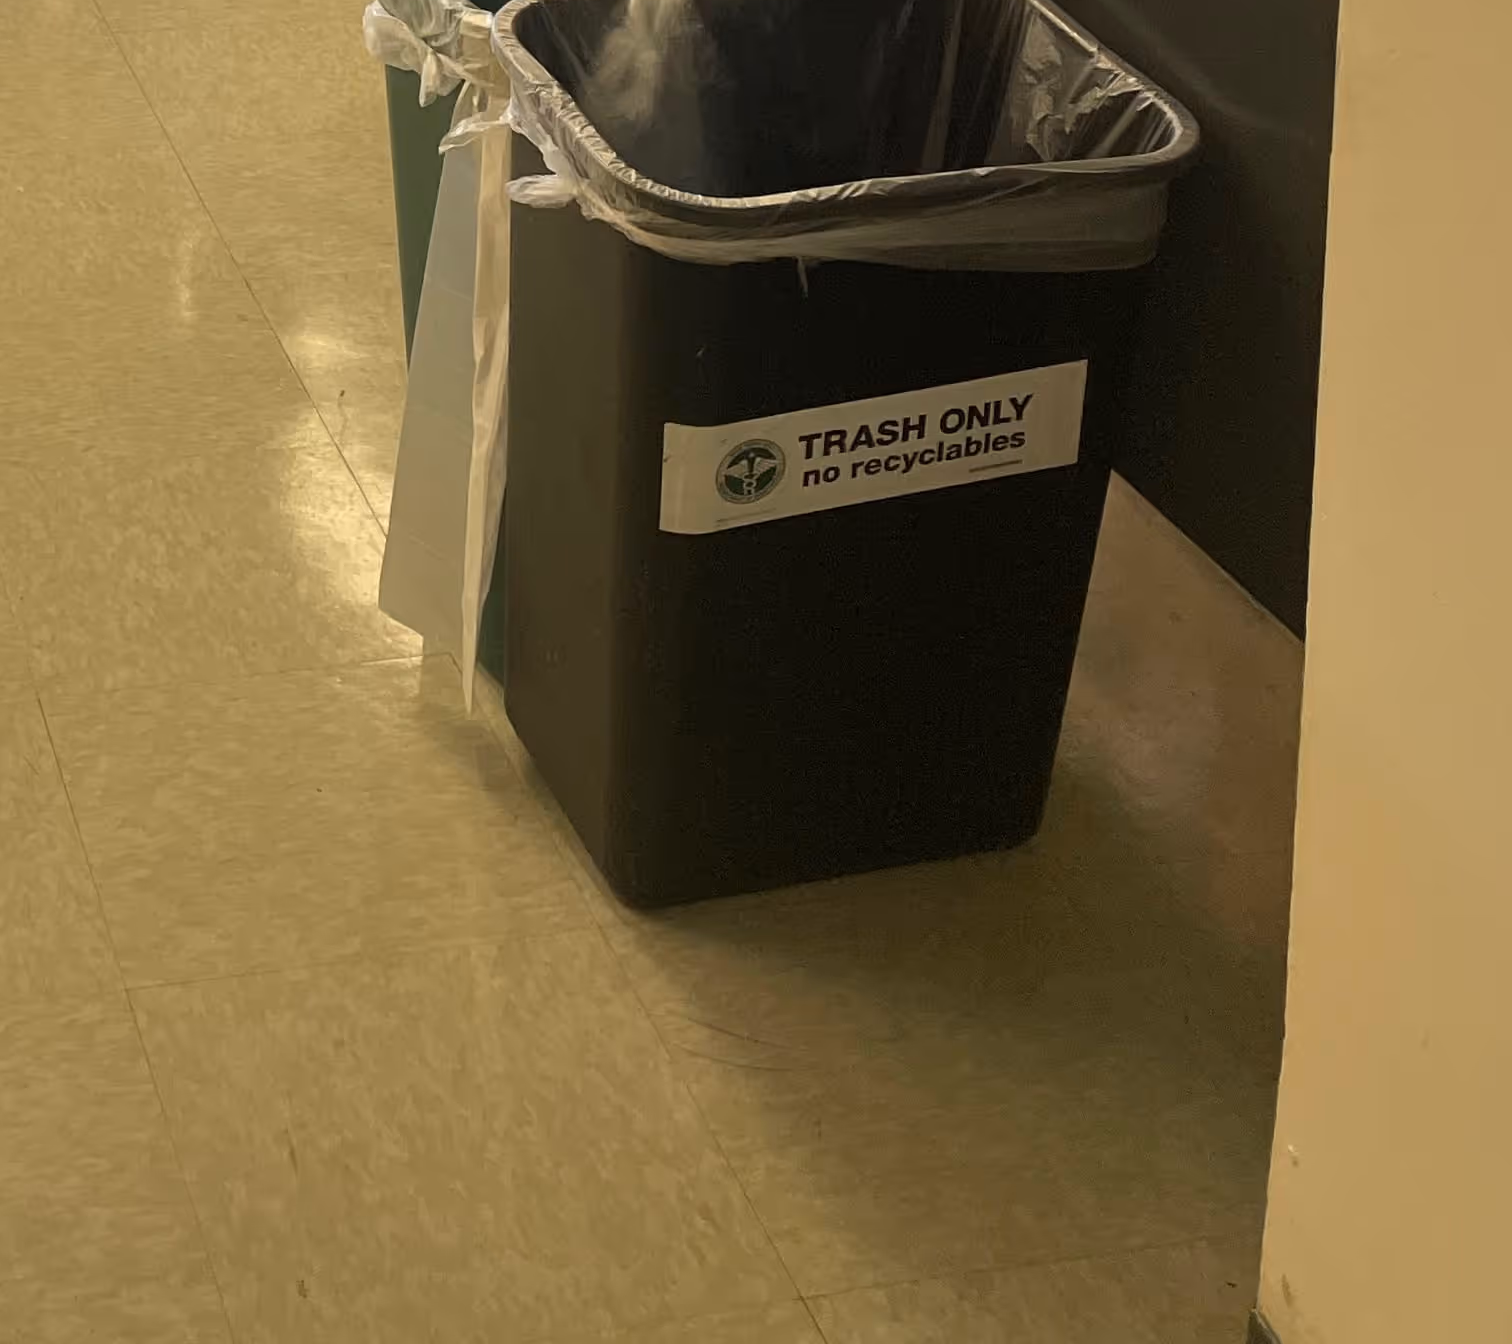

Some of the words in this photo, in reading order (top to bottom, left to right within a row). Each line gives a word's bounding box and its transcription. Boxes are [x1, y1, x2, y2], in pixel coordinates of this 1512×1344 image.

[798, 413, 927, 460] TRASH
[939, 392, 1035, 435] ONLY
[802, 463, 840, 488] no
[851, 430, 1027, 480] recyclables
